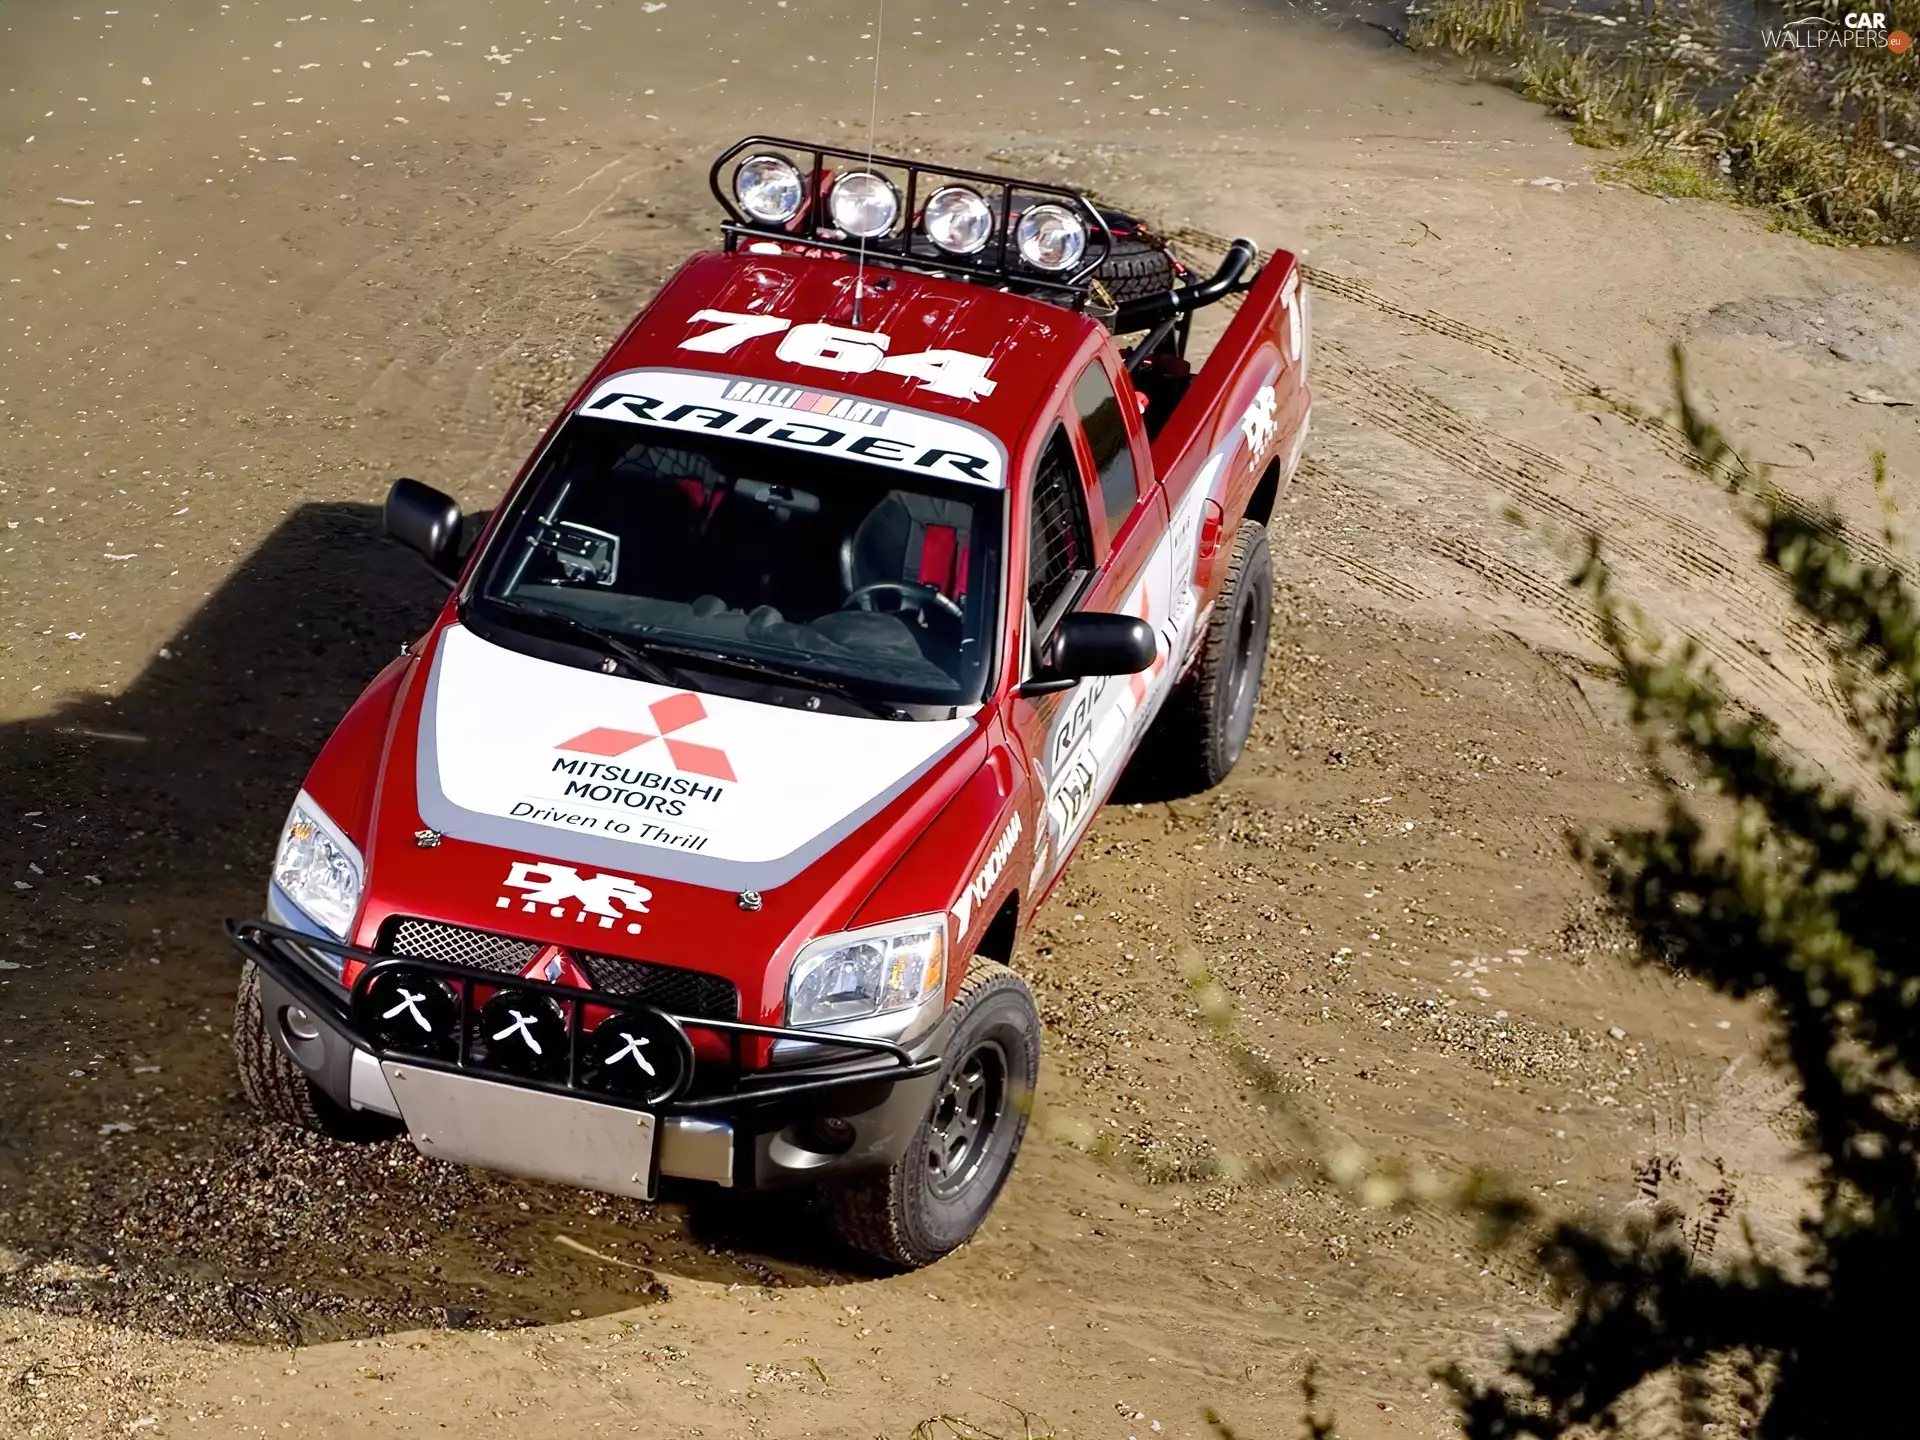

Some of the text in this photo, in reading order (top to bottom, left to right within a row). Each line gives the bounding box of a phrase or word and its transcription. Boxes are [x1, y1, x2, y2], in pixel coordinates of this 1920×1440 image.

[677, 309, 997, 403] 764
[588, 392, 993, 483] RAIDER
[551, 757, 724, 803] MITSUBISHI
[563, 780, 687, 817] MOTORS
[509, 801, 709, 851] Driven to Thrill
